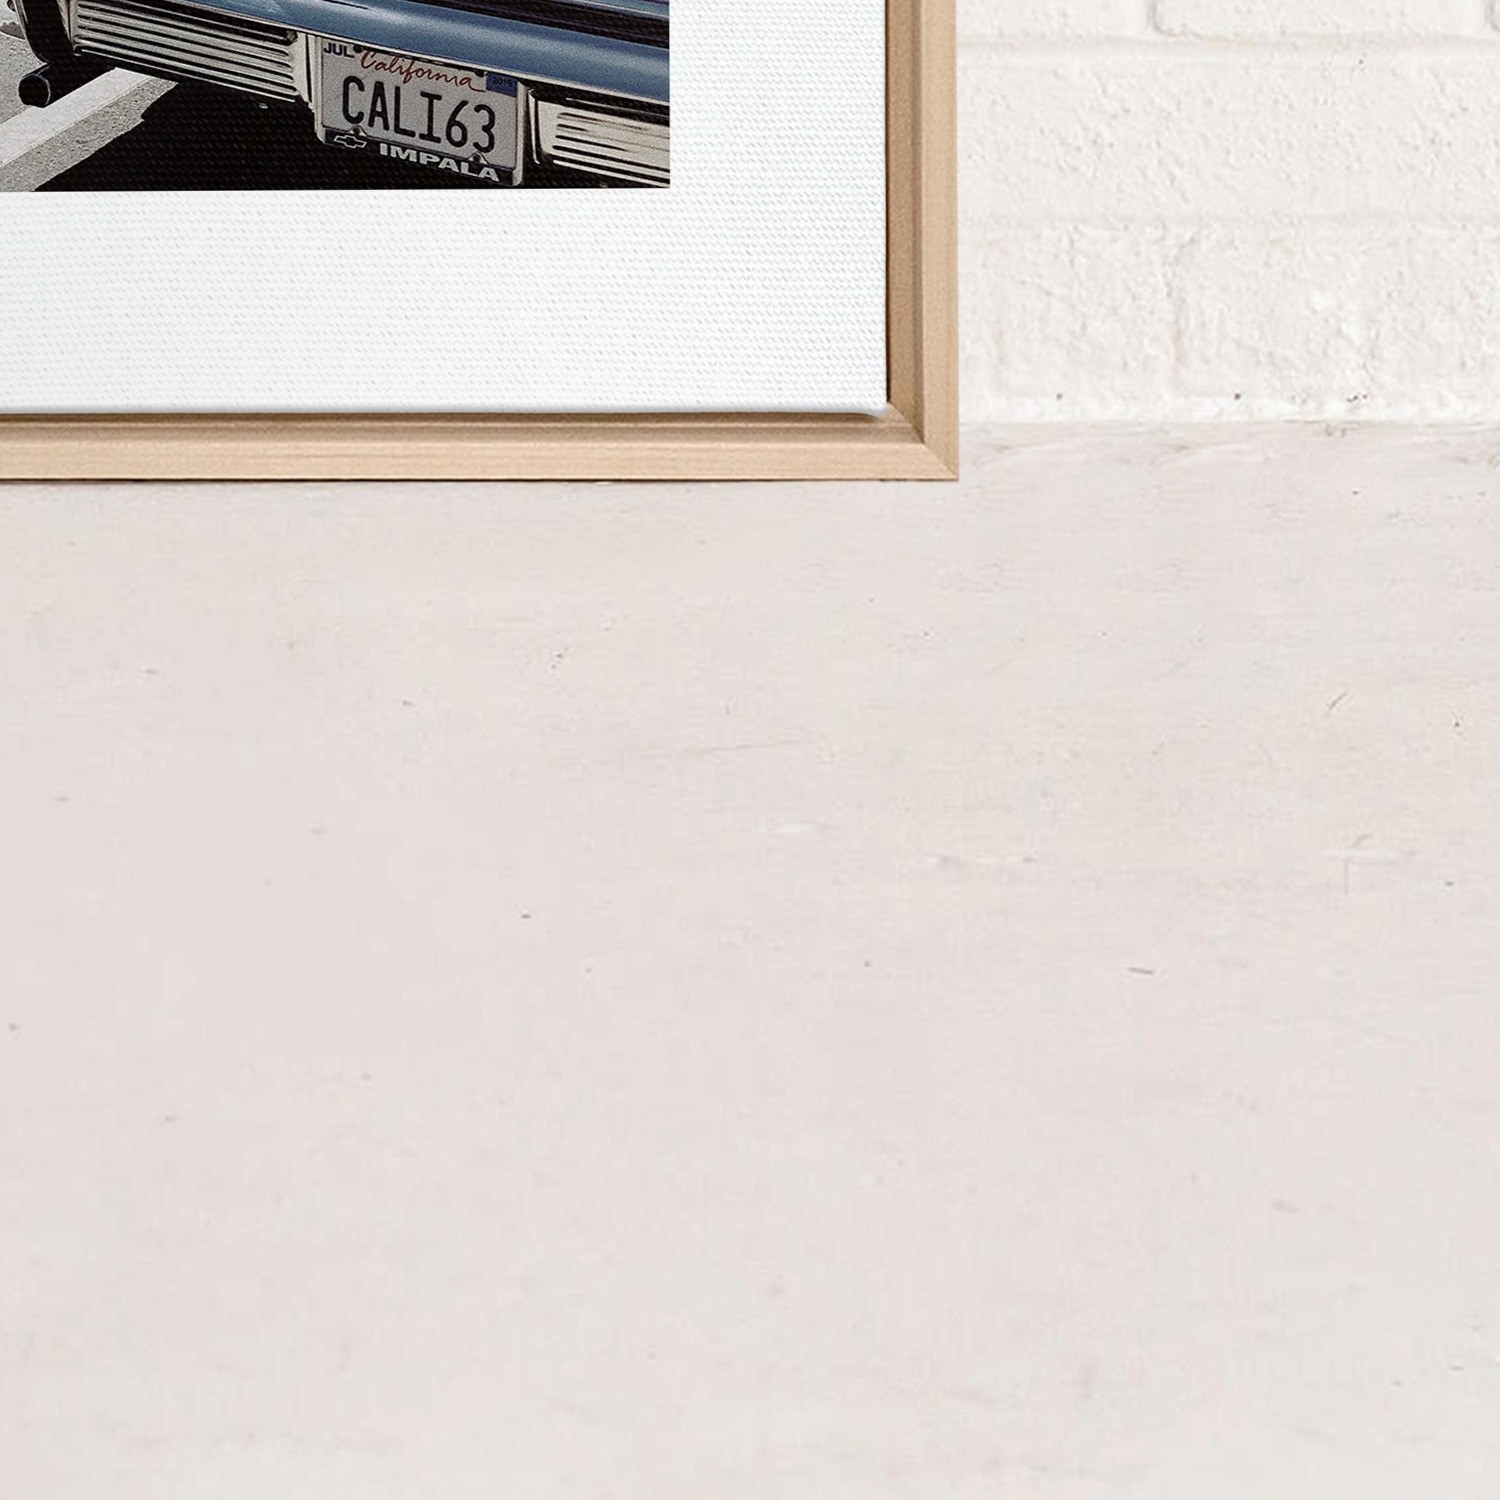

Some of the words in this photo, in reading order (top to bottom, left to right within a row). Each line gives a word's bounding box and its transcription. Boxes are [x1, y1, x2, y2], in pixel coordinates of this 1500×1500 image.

[323, 42, 355, 59] JUL
[361, 49, 486, 93] California
[342, 75, 496, 154] CALI63
[379, 143, 500, 183] IMPALA
